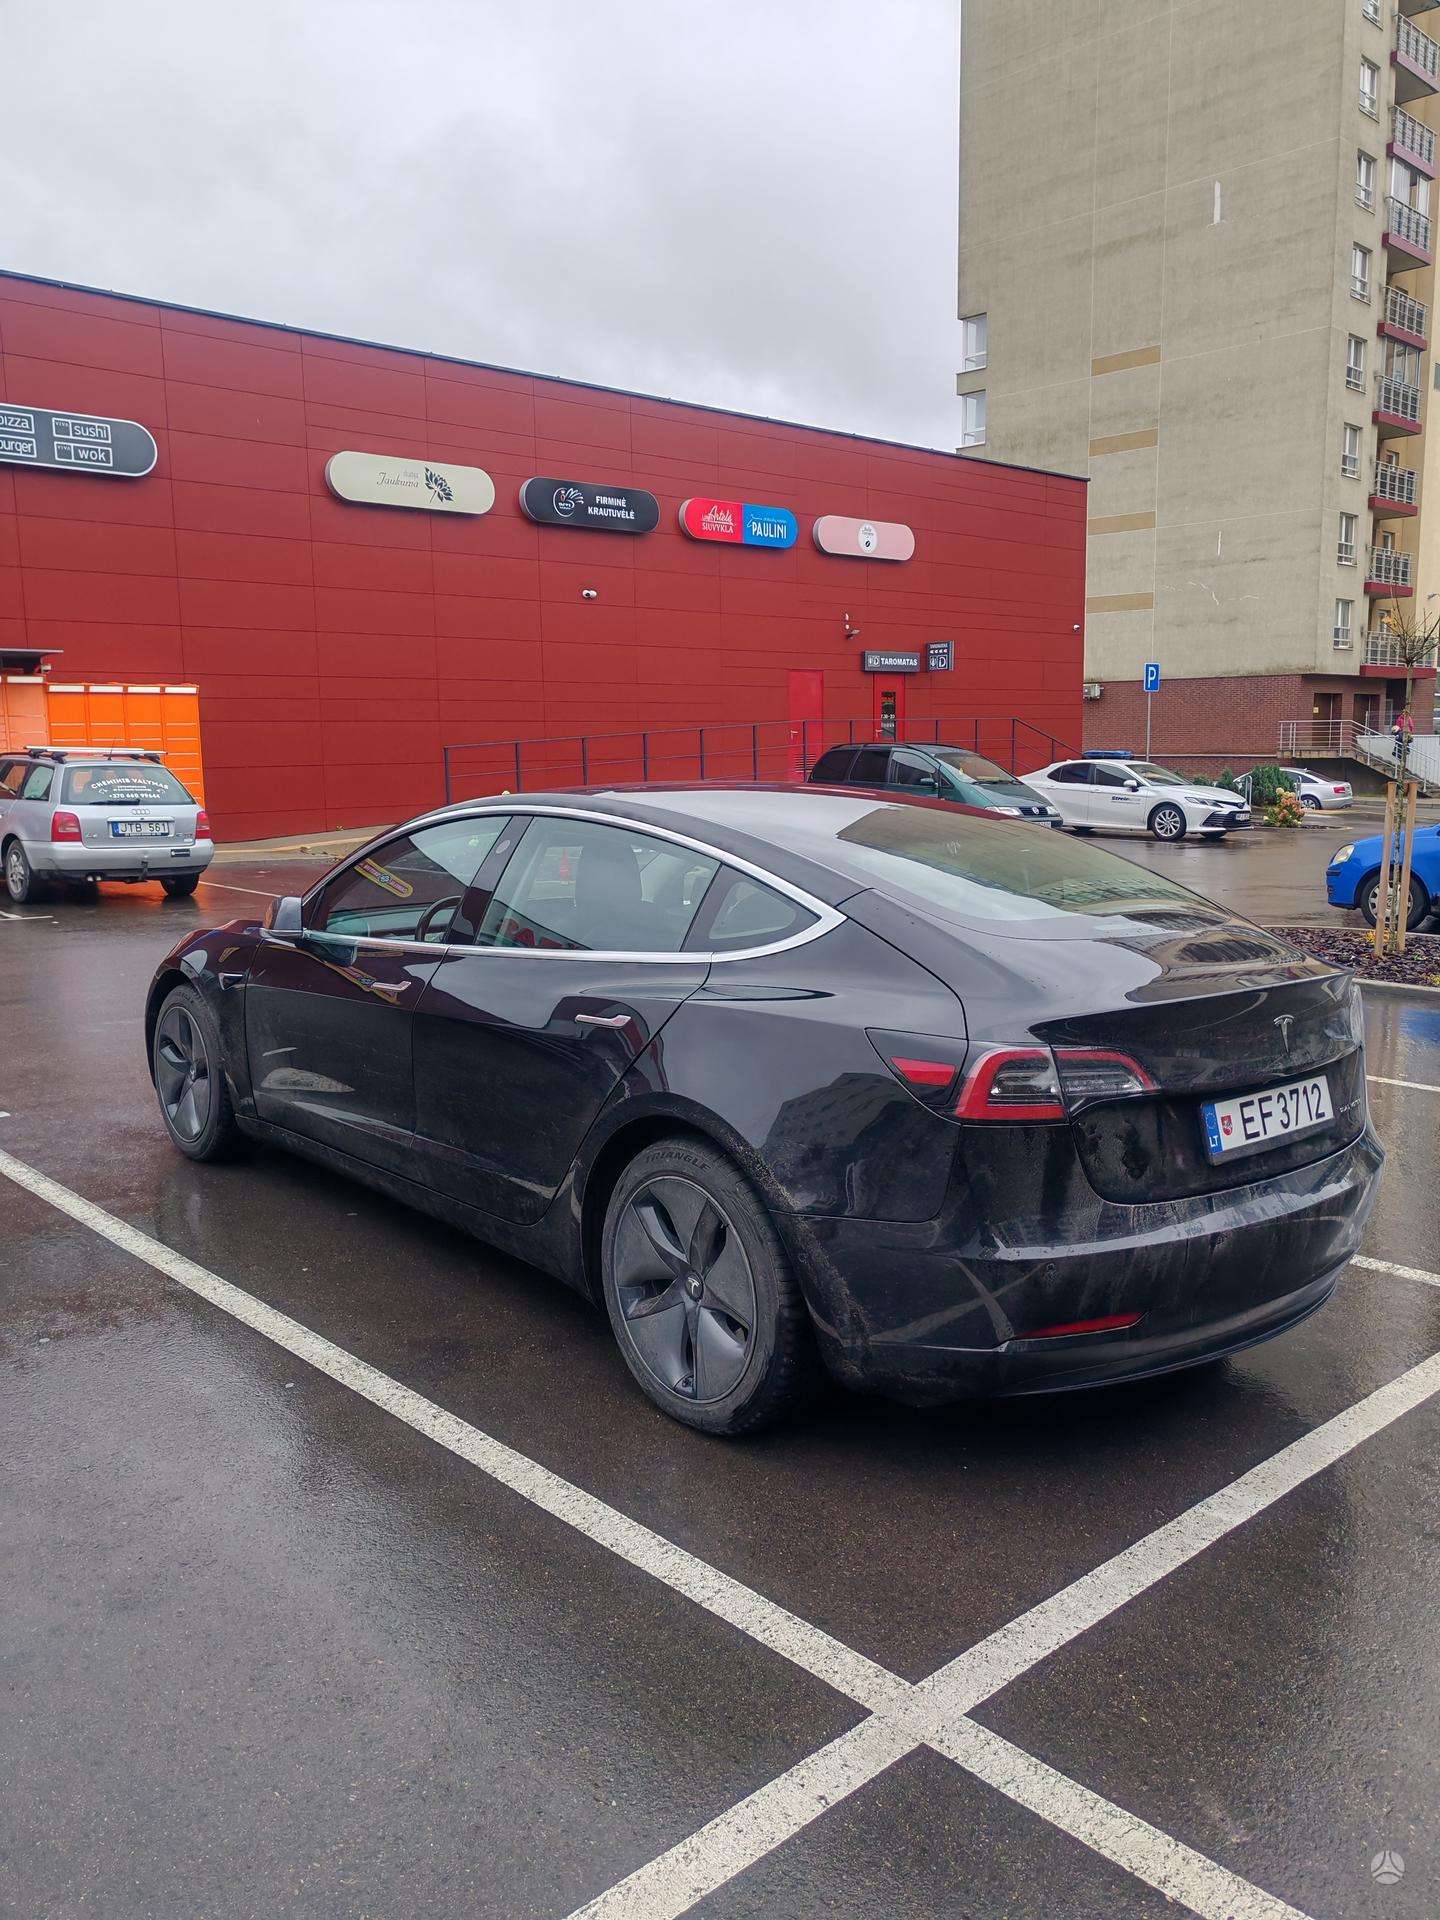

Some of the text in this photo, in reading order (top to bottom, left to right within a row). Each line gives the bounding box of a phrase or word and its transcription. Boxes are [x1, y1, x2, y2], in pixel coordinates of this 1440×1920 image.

[73, 424, 107, 438] sushi
[595, 496, 627, 507] FIRMINĖ
[588, 506, 635, 520] KRAUTUVĖLĖ
[752, 521, 787, 539] PAULINI
[880, 657, 918, 666] TAROMATAS
[1148, 666, 1157, 688] P
[121, 822, 143, 833] JTB
[148, 822, 167, 832] 561
[1239, 1083, 1325, 1140] EF3712
[1209, 1135, 1219, 1148] LT
